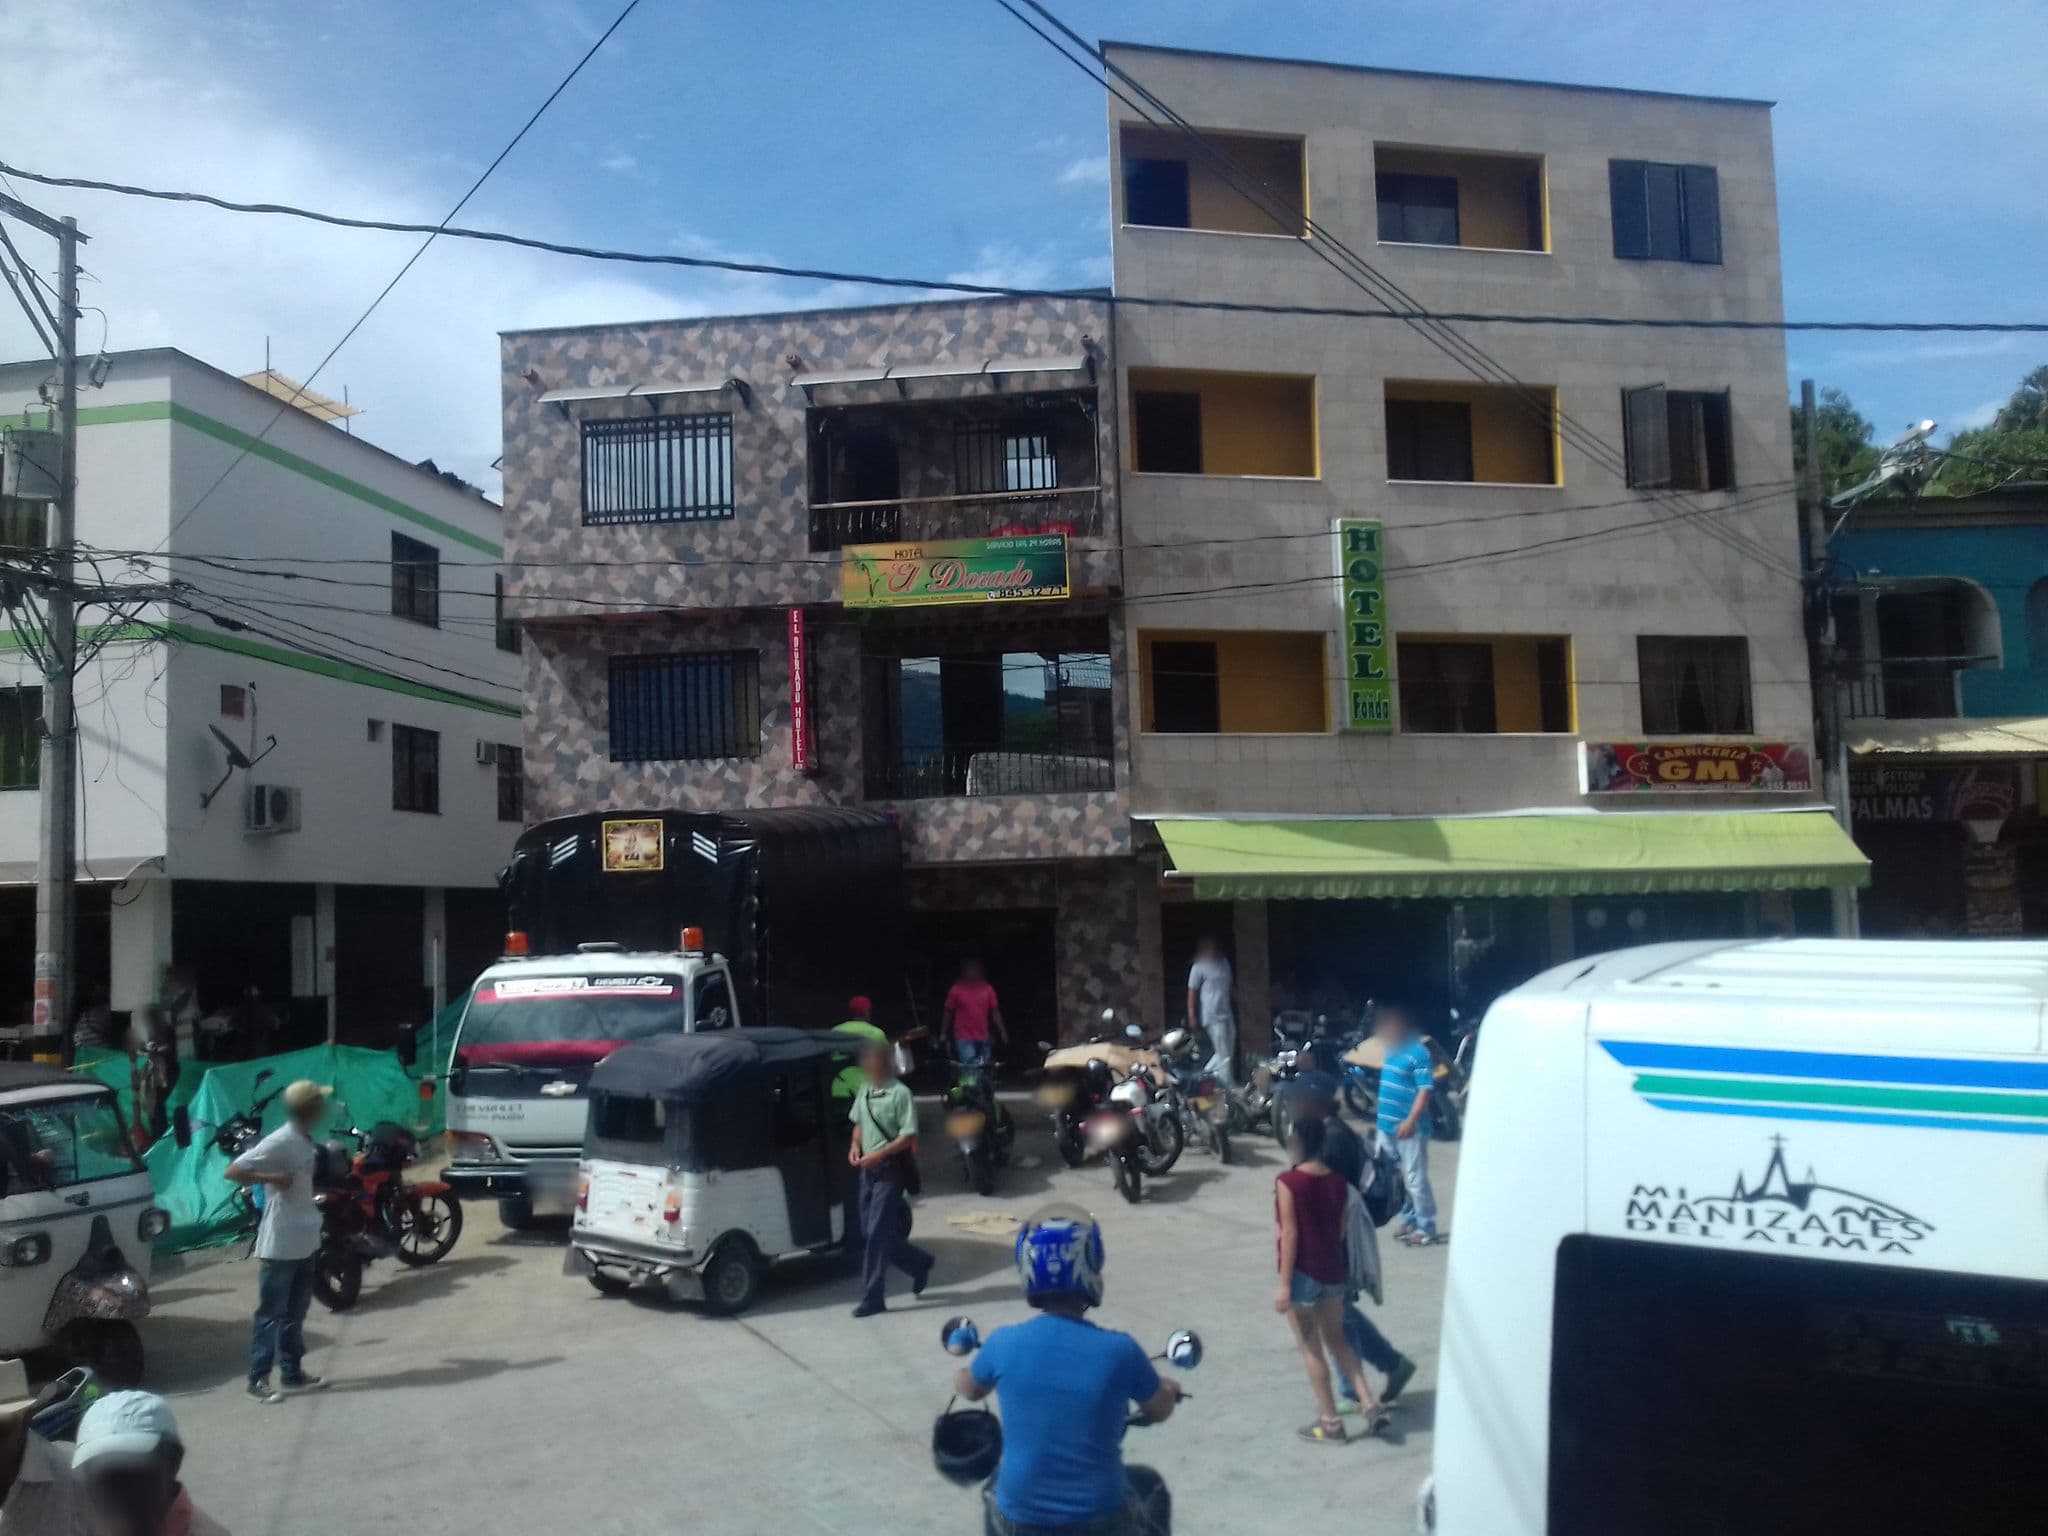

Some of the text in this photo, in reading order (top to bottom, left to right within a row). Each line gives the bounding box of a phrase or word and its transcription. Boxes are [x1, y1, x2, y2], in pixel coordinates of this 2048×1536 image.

[894, 549, 923, 559] HOTEL
[888, 559, 1034, 593] El Dorado
[999, 588, 1023, 598] 845
[1047, 585, 1063, 595] 71
[1347, 527, 1384, 680] HOTEL
[793, 636, 801, 703] DORADO
[795, 706, 803, 763] HOTEL
[1658, 760, 1740, 781] GM
[1633, 1185, 1686, 1199] MI
[1626, 1218, 1913, 1255] DEL ALMA
[1627, 1200, 1924, 1240] MANIZALES
